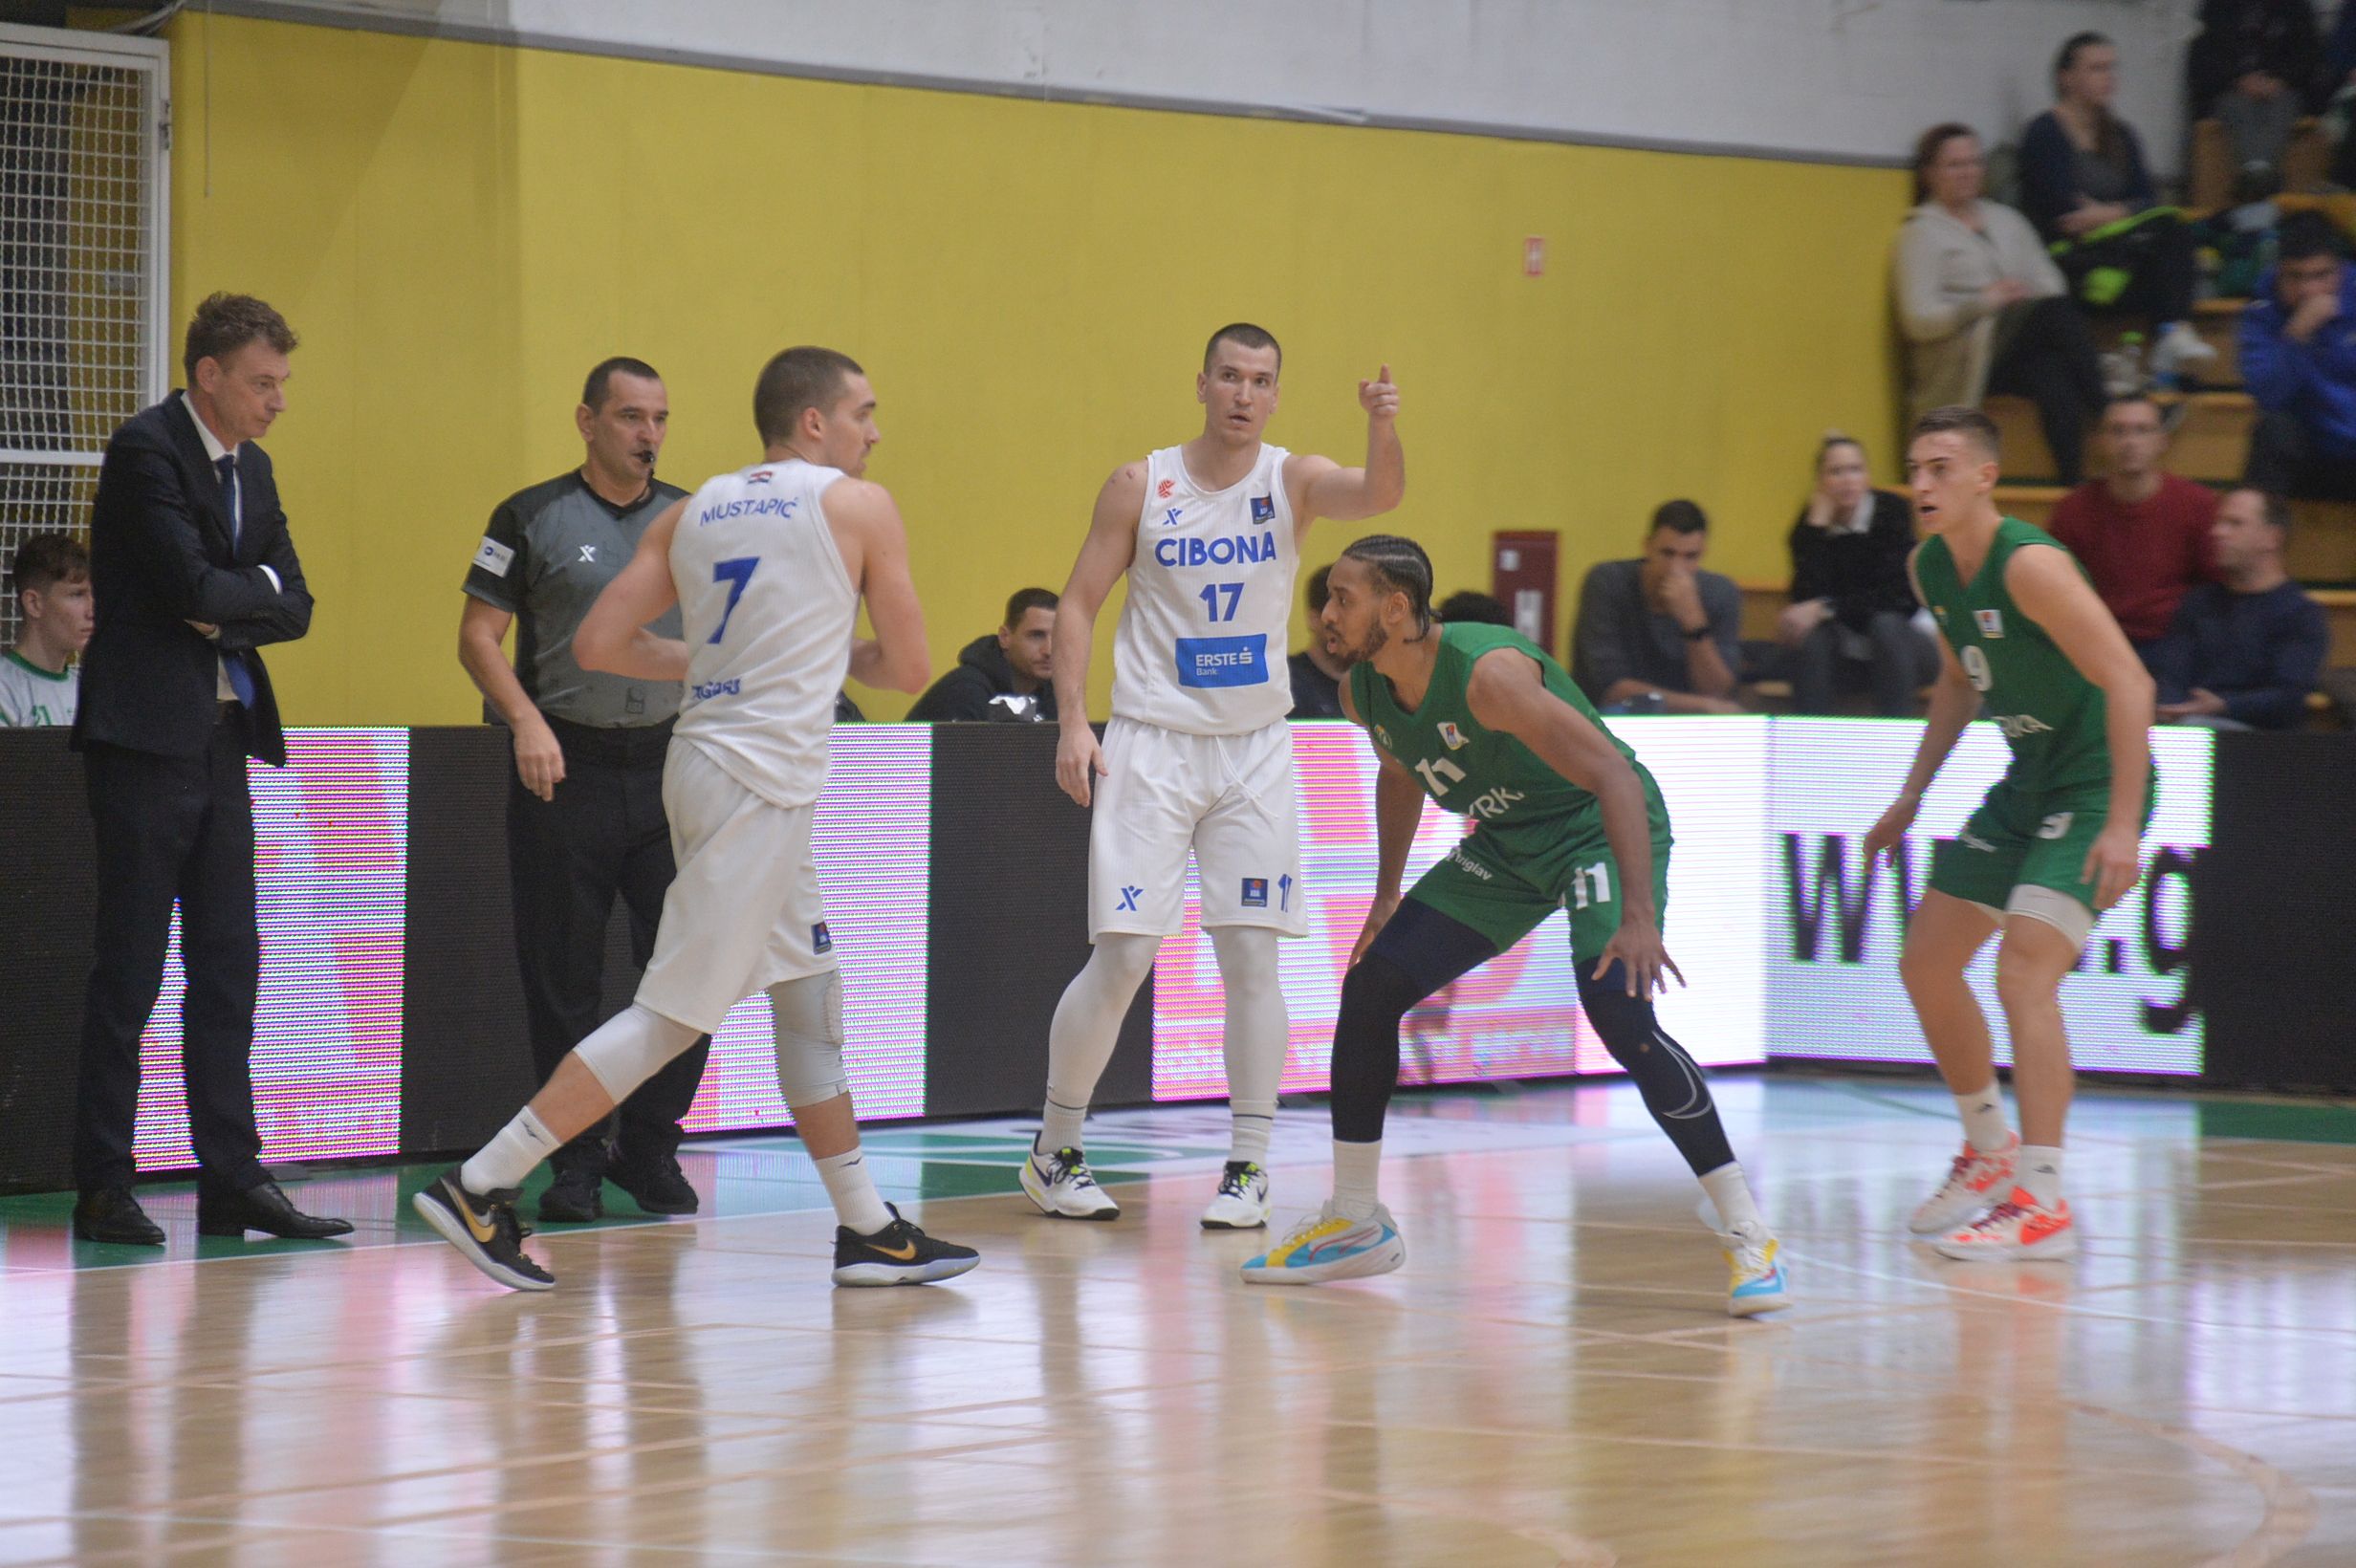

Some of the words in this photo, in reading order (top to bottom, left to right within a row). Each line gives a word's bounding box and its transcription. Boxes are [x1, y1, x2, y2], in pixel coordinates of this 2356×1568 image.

[699, 497, 797, 526] MUSTAPIĆ
[1155, 531, 1277, 567] CIBONA
[707, 555, 761, 644] 7
[1199, 582, 1245, 622] 17
[1195, 652, 1238, 667] ERSTE
[1195, 667, 1218, 676] Bank
[1469, 787, 1525, 819] RK
